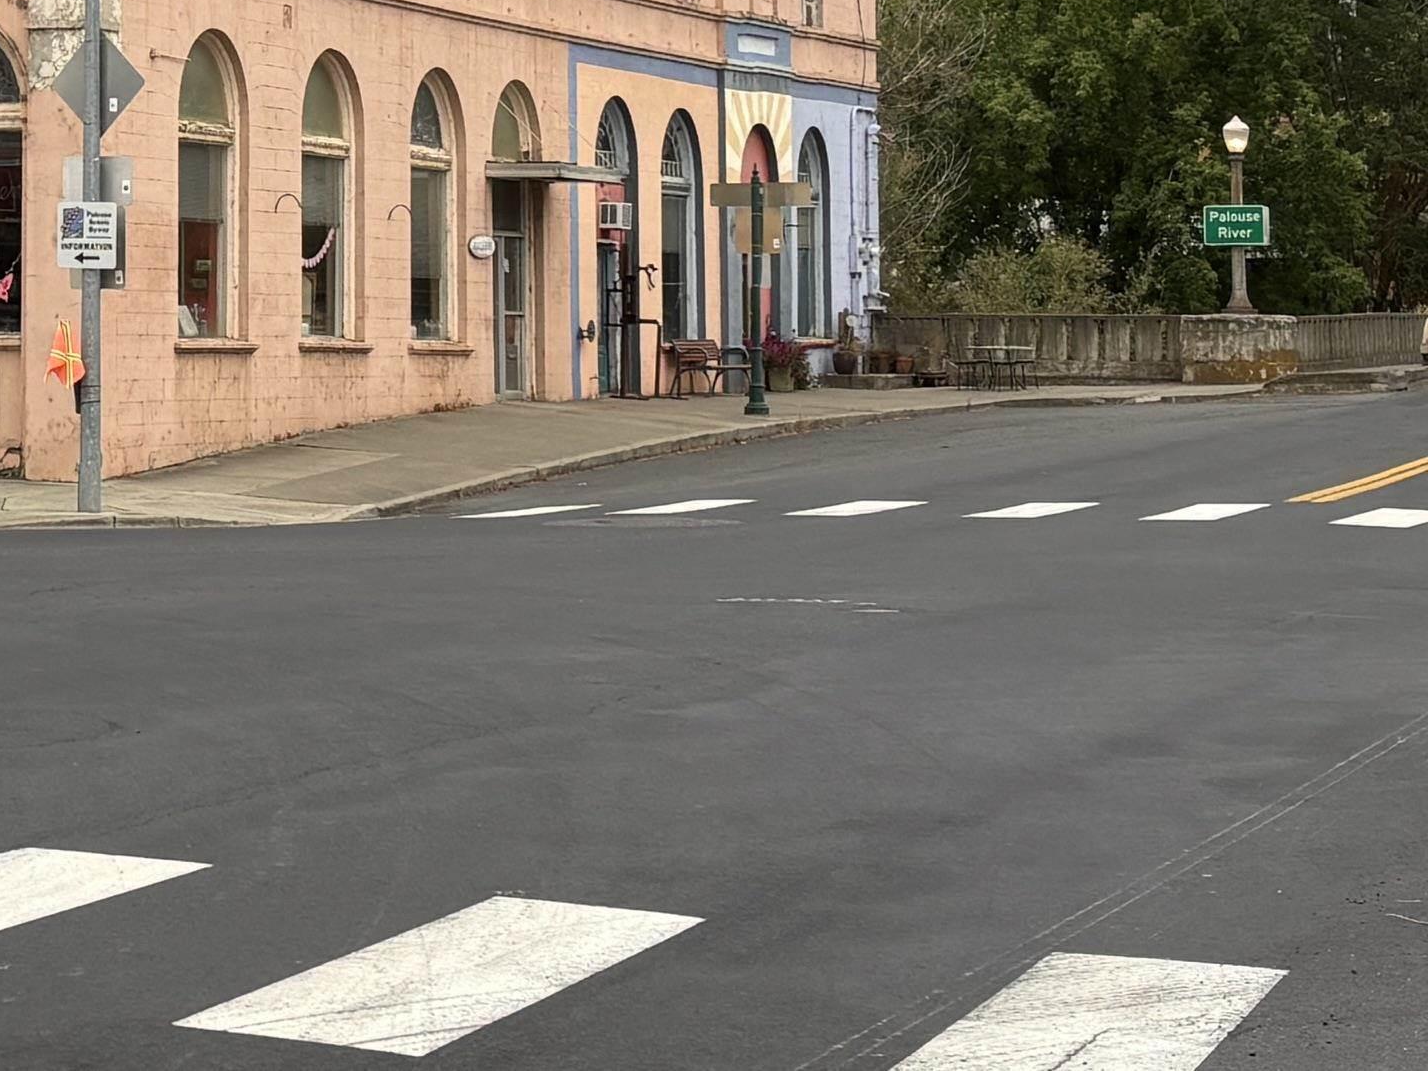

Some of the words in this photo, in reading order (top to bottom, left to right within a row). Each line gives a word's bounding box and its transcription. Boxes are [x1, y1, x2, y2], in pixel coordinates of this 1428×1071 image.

[1209, 210, 1261, 222] Palouse
[1217, 226, 1253, 239] River
[61, 242, 113, 250] INFORMATION
